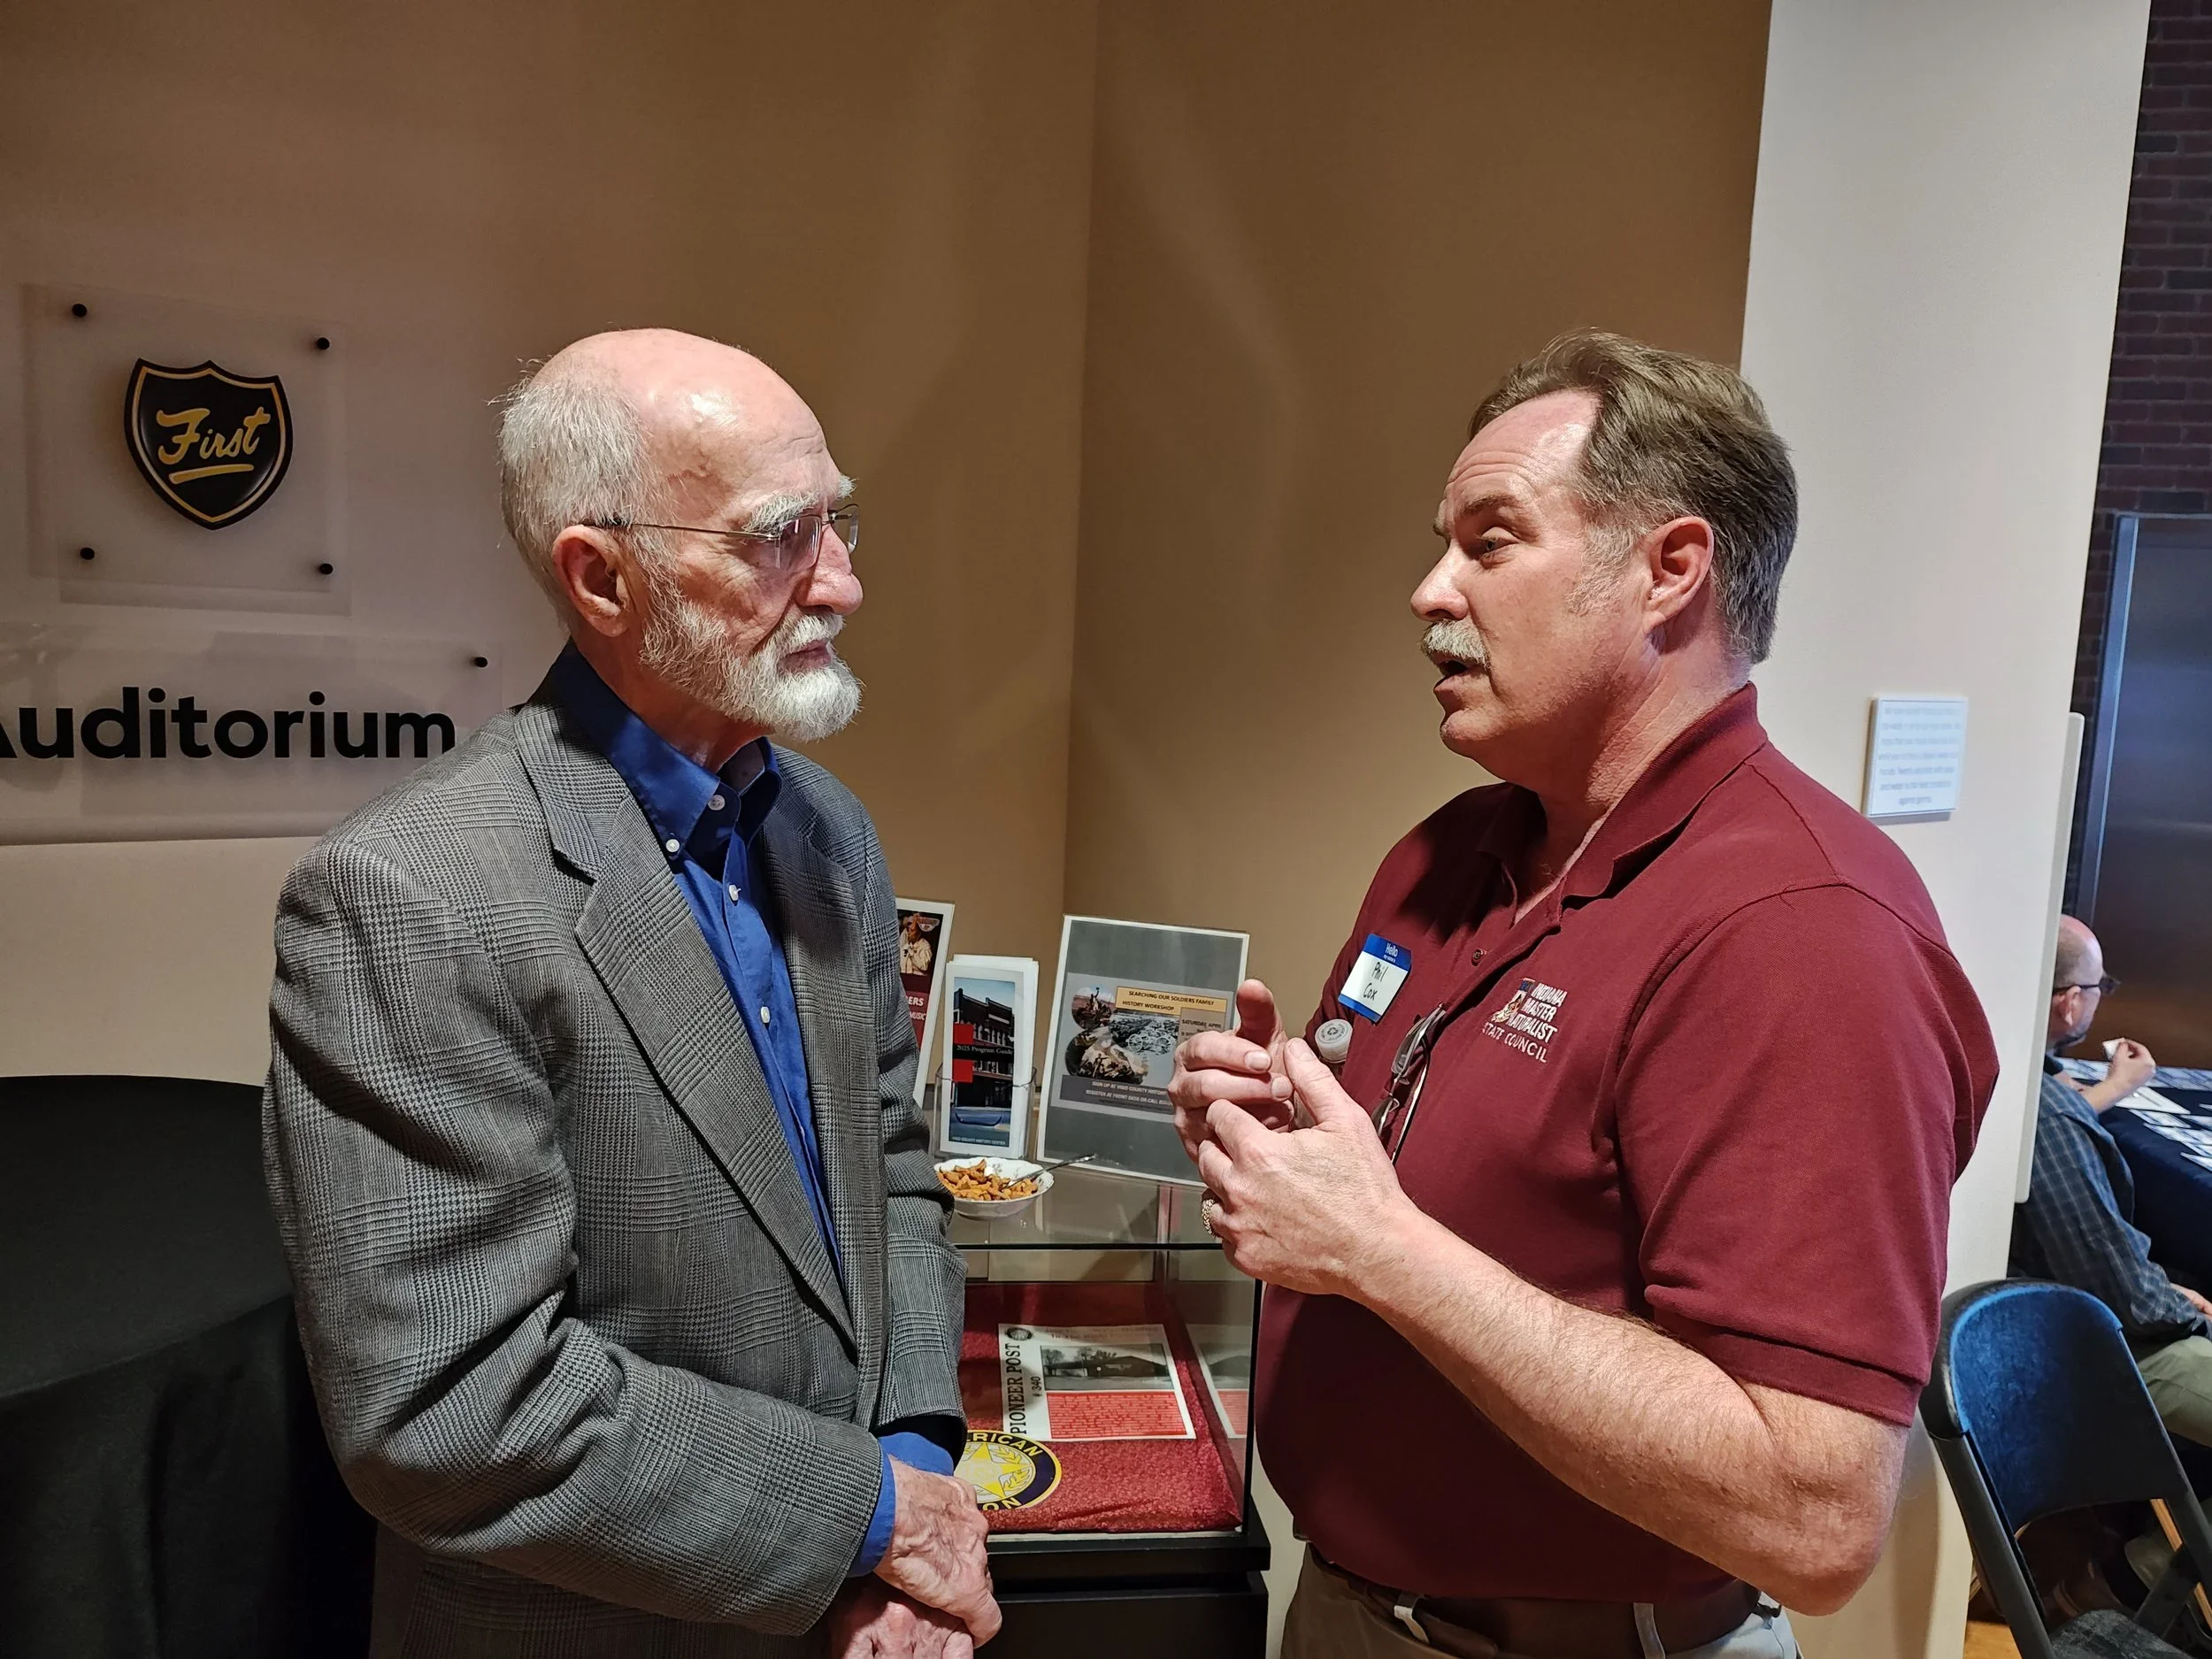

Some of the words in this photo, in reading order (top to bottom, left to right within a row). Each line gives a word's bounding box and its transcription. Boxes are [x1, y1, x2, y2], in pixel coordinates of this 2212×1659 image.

[156, 406, 271, 465] First
[0, 687, 456, 760] uditorium
[1371, 961, 1388, 982] Phil
[905, 995, 925, 1006] ERS
[1171, 995, 1195, 1003] SOLDIERS
[1195, 997, 1215, 1006] FAMILY
[1363, 982, 1378, 1001] Cox
[1531, 982, 1568, 1007] INDIANA
[1521, 997, 1557, 1022] MASTER
[1482, 1021, 1505, 1041] STATE
[1504, 1033, 1547, 1063] COUNCIL
[1005, 1343, 1022, 1373] POST
[1030, 1376, 1042, 1392] 340
[1006, 1377, 1027, 1434] PIONEER
[967, 1432, 1043, 1456] RICAN
